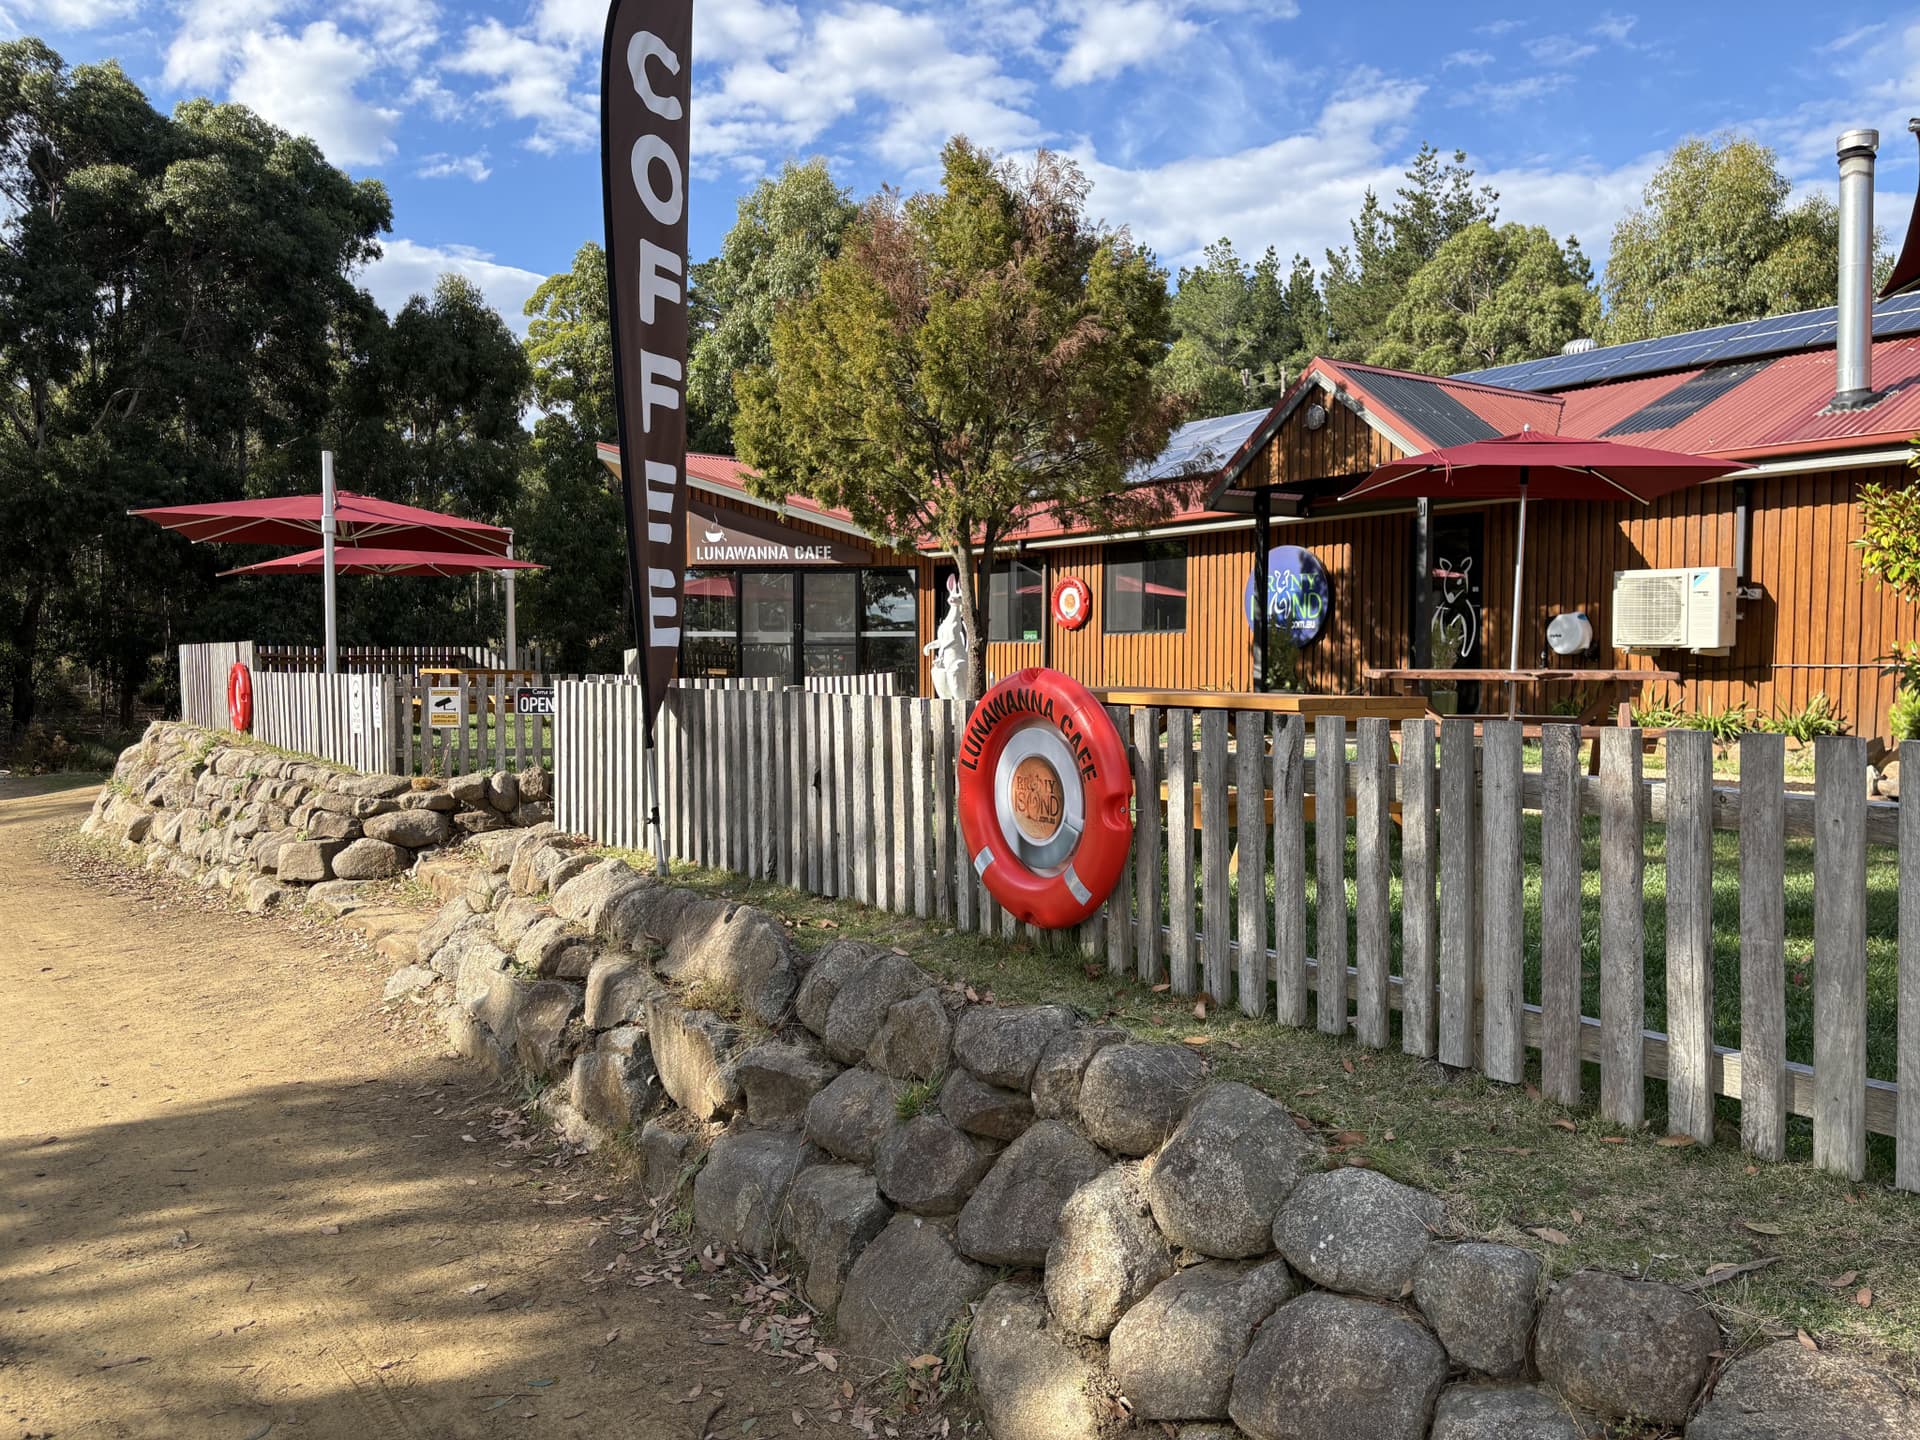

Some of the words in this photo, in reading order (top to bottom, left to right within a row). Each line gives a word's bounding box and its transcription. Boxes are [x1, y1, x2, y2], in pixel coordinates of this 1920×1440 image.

[626, 30, 684, 648] COFFEE
[696, 545, 789, 560] LUNAWANNA
[794, 545, 832, 560] CAFE
[520, 696, 556, 712] OPEN
[961, 688, 1055, 771] LUNAWANNA
[1059, 714, 1098, 783] CAFE
